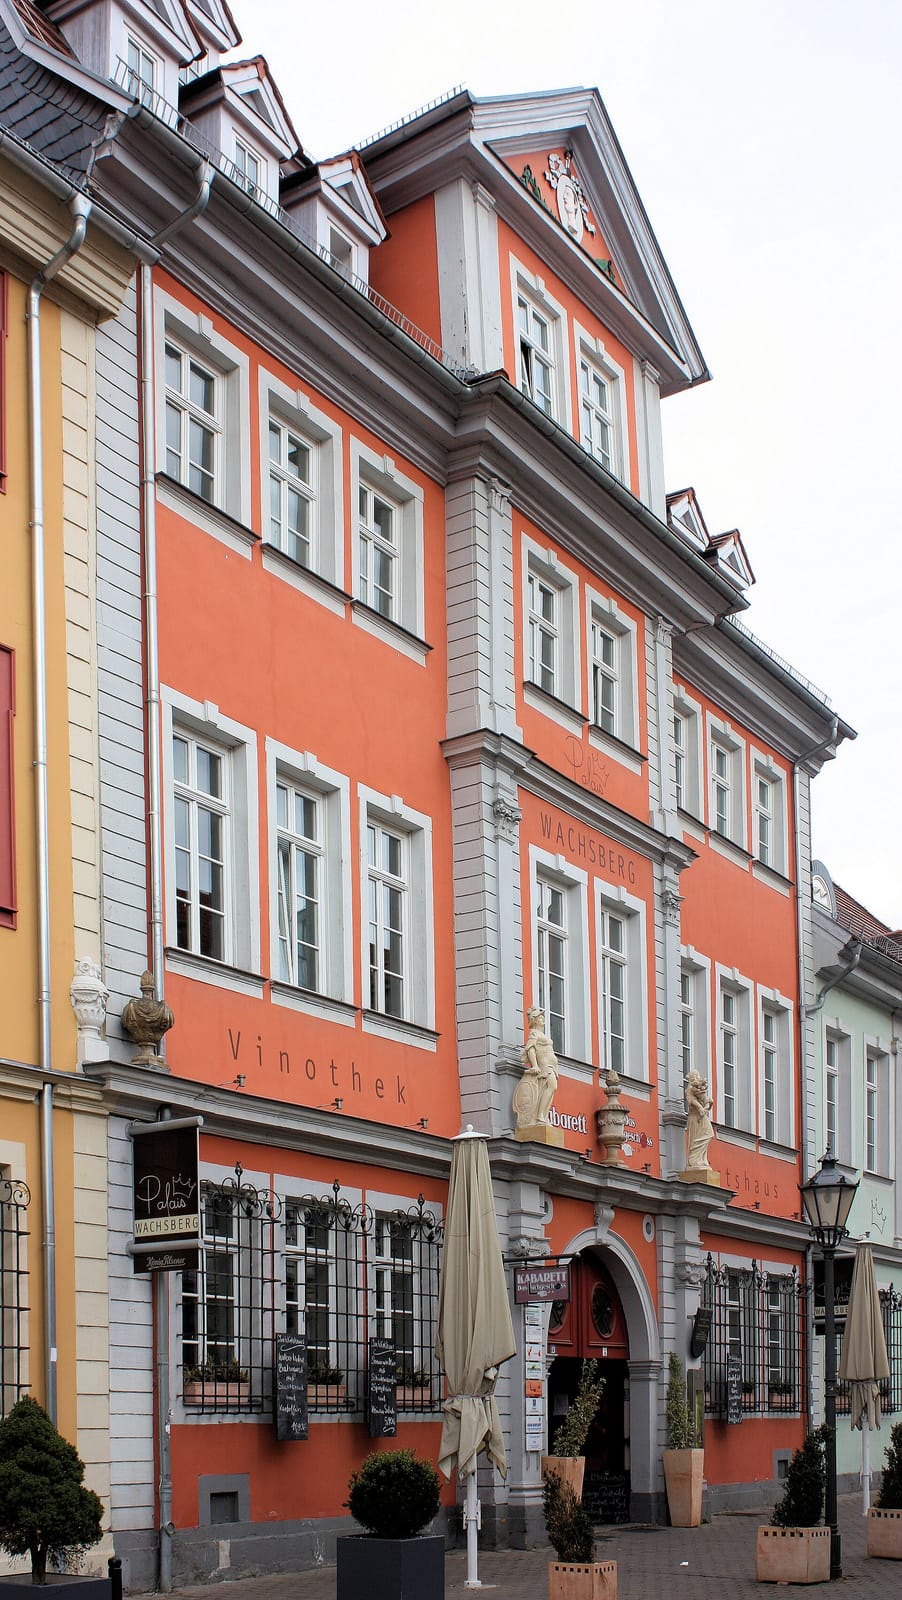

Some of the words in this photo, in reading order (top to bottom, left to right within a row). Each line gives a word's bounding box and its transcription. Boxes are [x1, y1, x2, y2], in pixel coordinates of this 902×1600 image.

[540, 811, 636, 885] WACHSBERG
[228, 1028, 406, 1104] Vinothek
[547, 1106, 588, 1134] abarett
[136, 1175, 187, 1216] Palais
[725, 1170, 779, 1199] tshaus
[135, 1216, 199, 1234] WACHSBERG
[517, 1270, 568, 1284] KABARETT
